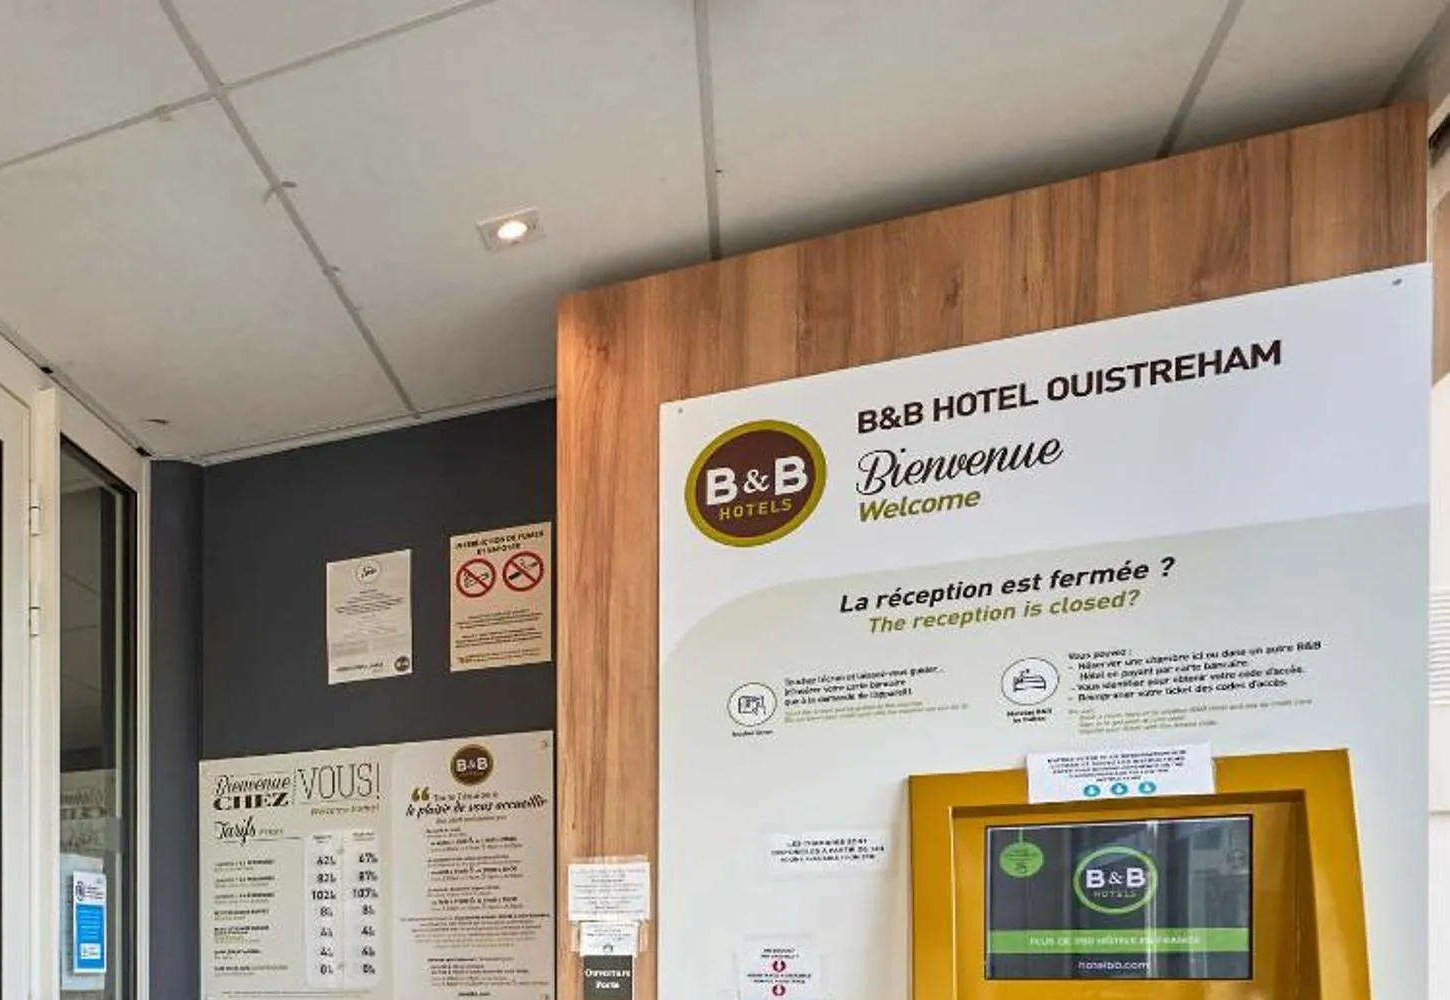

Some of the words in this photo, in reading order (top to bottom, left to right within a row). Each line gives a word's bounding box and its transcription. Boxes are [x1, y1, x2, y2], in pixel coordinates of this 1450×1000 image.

[857, 401, 923, 434] B&B
[933, 383, 1039, 422] HOTEL
[1048, 339, 1283, 403] OUISTREHAM
[706, 455, 808, 506] B&B
[856, 438, 1063, 496] Bienvenue
[719, 498, 792, 520] HOTELS
[859, 490, 981, 522] Welcome
[840, 594, 868, 613] La
[876, 580, 993, 609] réception
[1001, 573, 1042, 596] est
[1049, 561, 1149, 590] fermée
[1159, 556, 1176, 577] ?
[869, 617, 906, 634] The
[913, 604, 1016, 630] reception
[1024, 600, 1042, 618] is
[1049, 588, 1141, 615] closed?
[212, 792, 289, 811] CHEZ
[214, 774, 290, 795] Bienvenue
[1085, 867, 1146, 888] B&B
